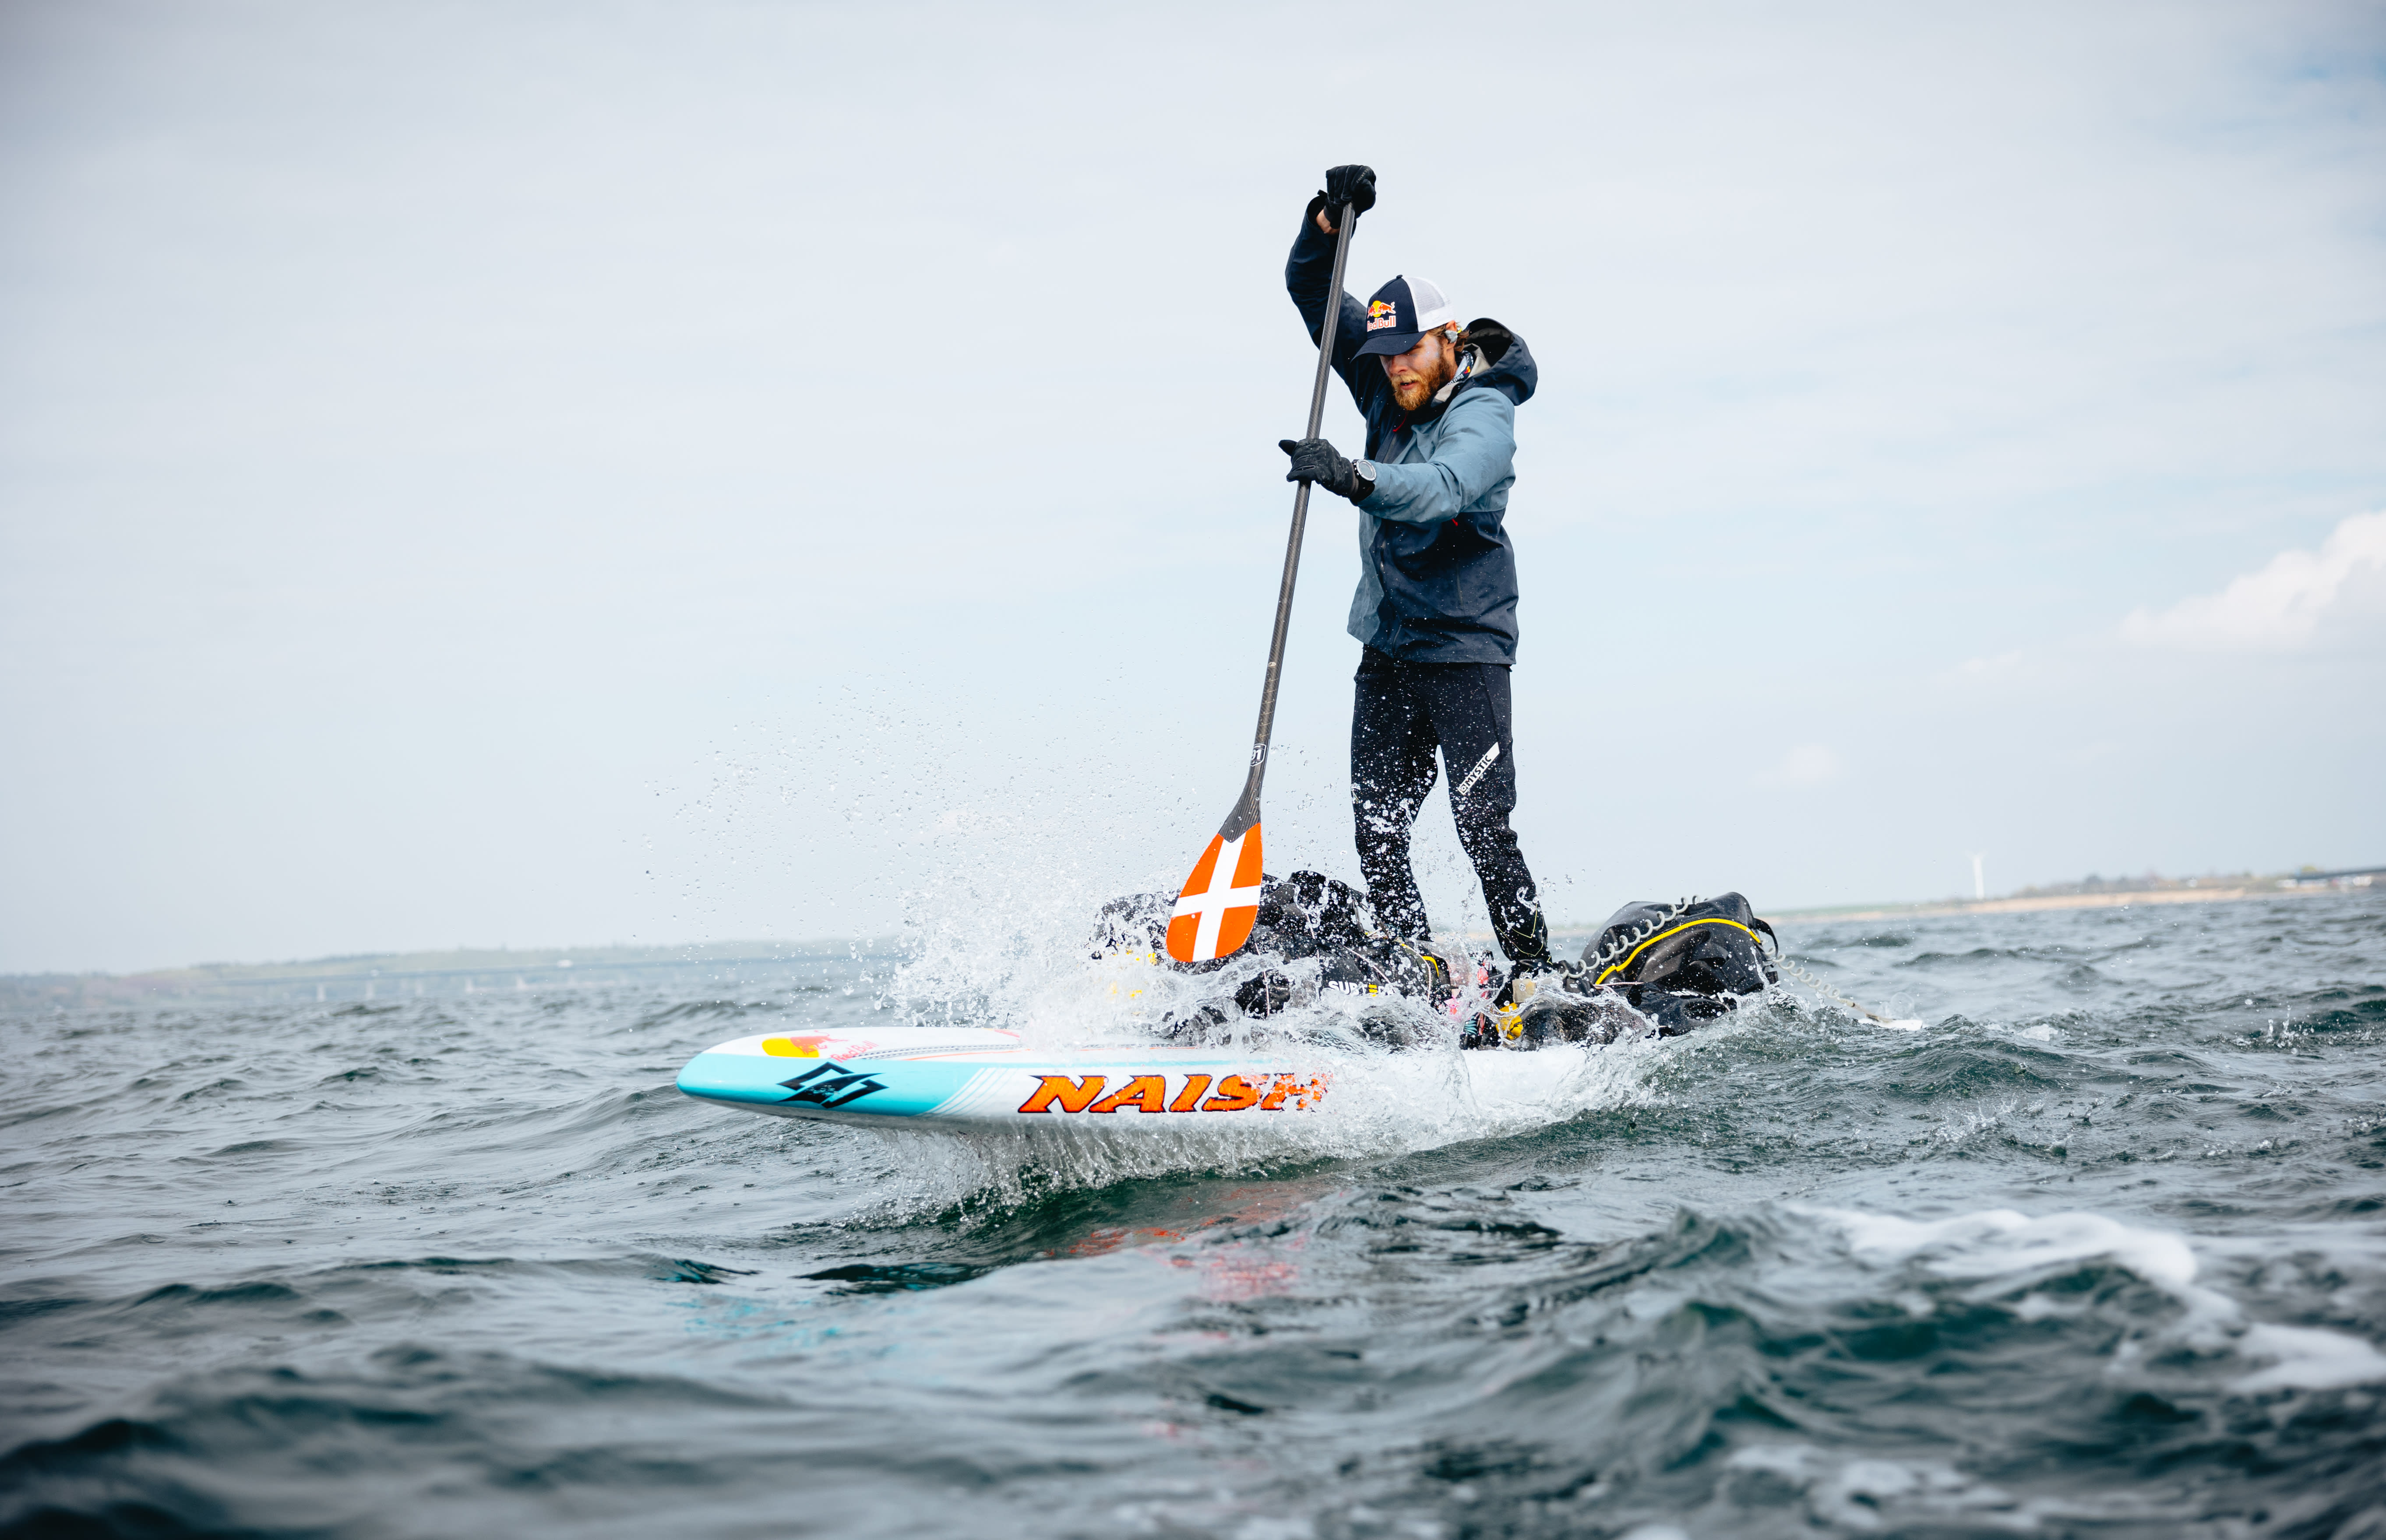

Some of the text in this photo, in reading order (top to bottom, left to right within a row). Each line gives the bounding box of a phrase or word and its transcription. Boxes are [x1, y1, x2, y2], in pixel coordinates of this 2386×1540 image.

[1378, 316, 1396, 328] Bull
[1464, 755, 1491, 786] MYSTIC
[830, 1040, 879, 1063] Red Bull
[1018, 1073, 1331, 1113] NAISH
